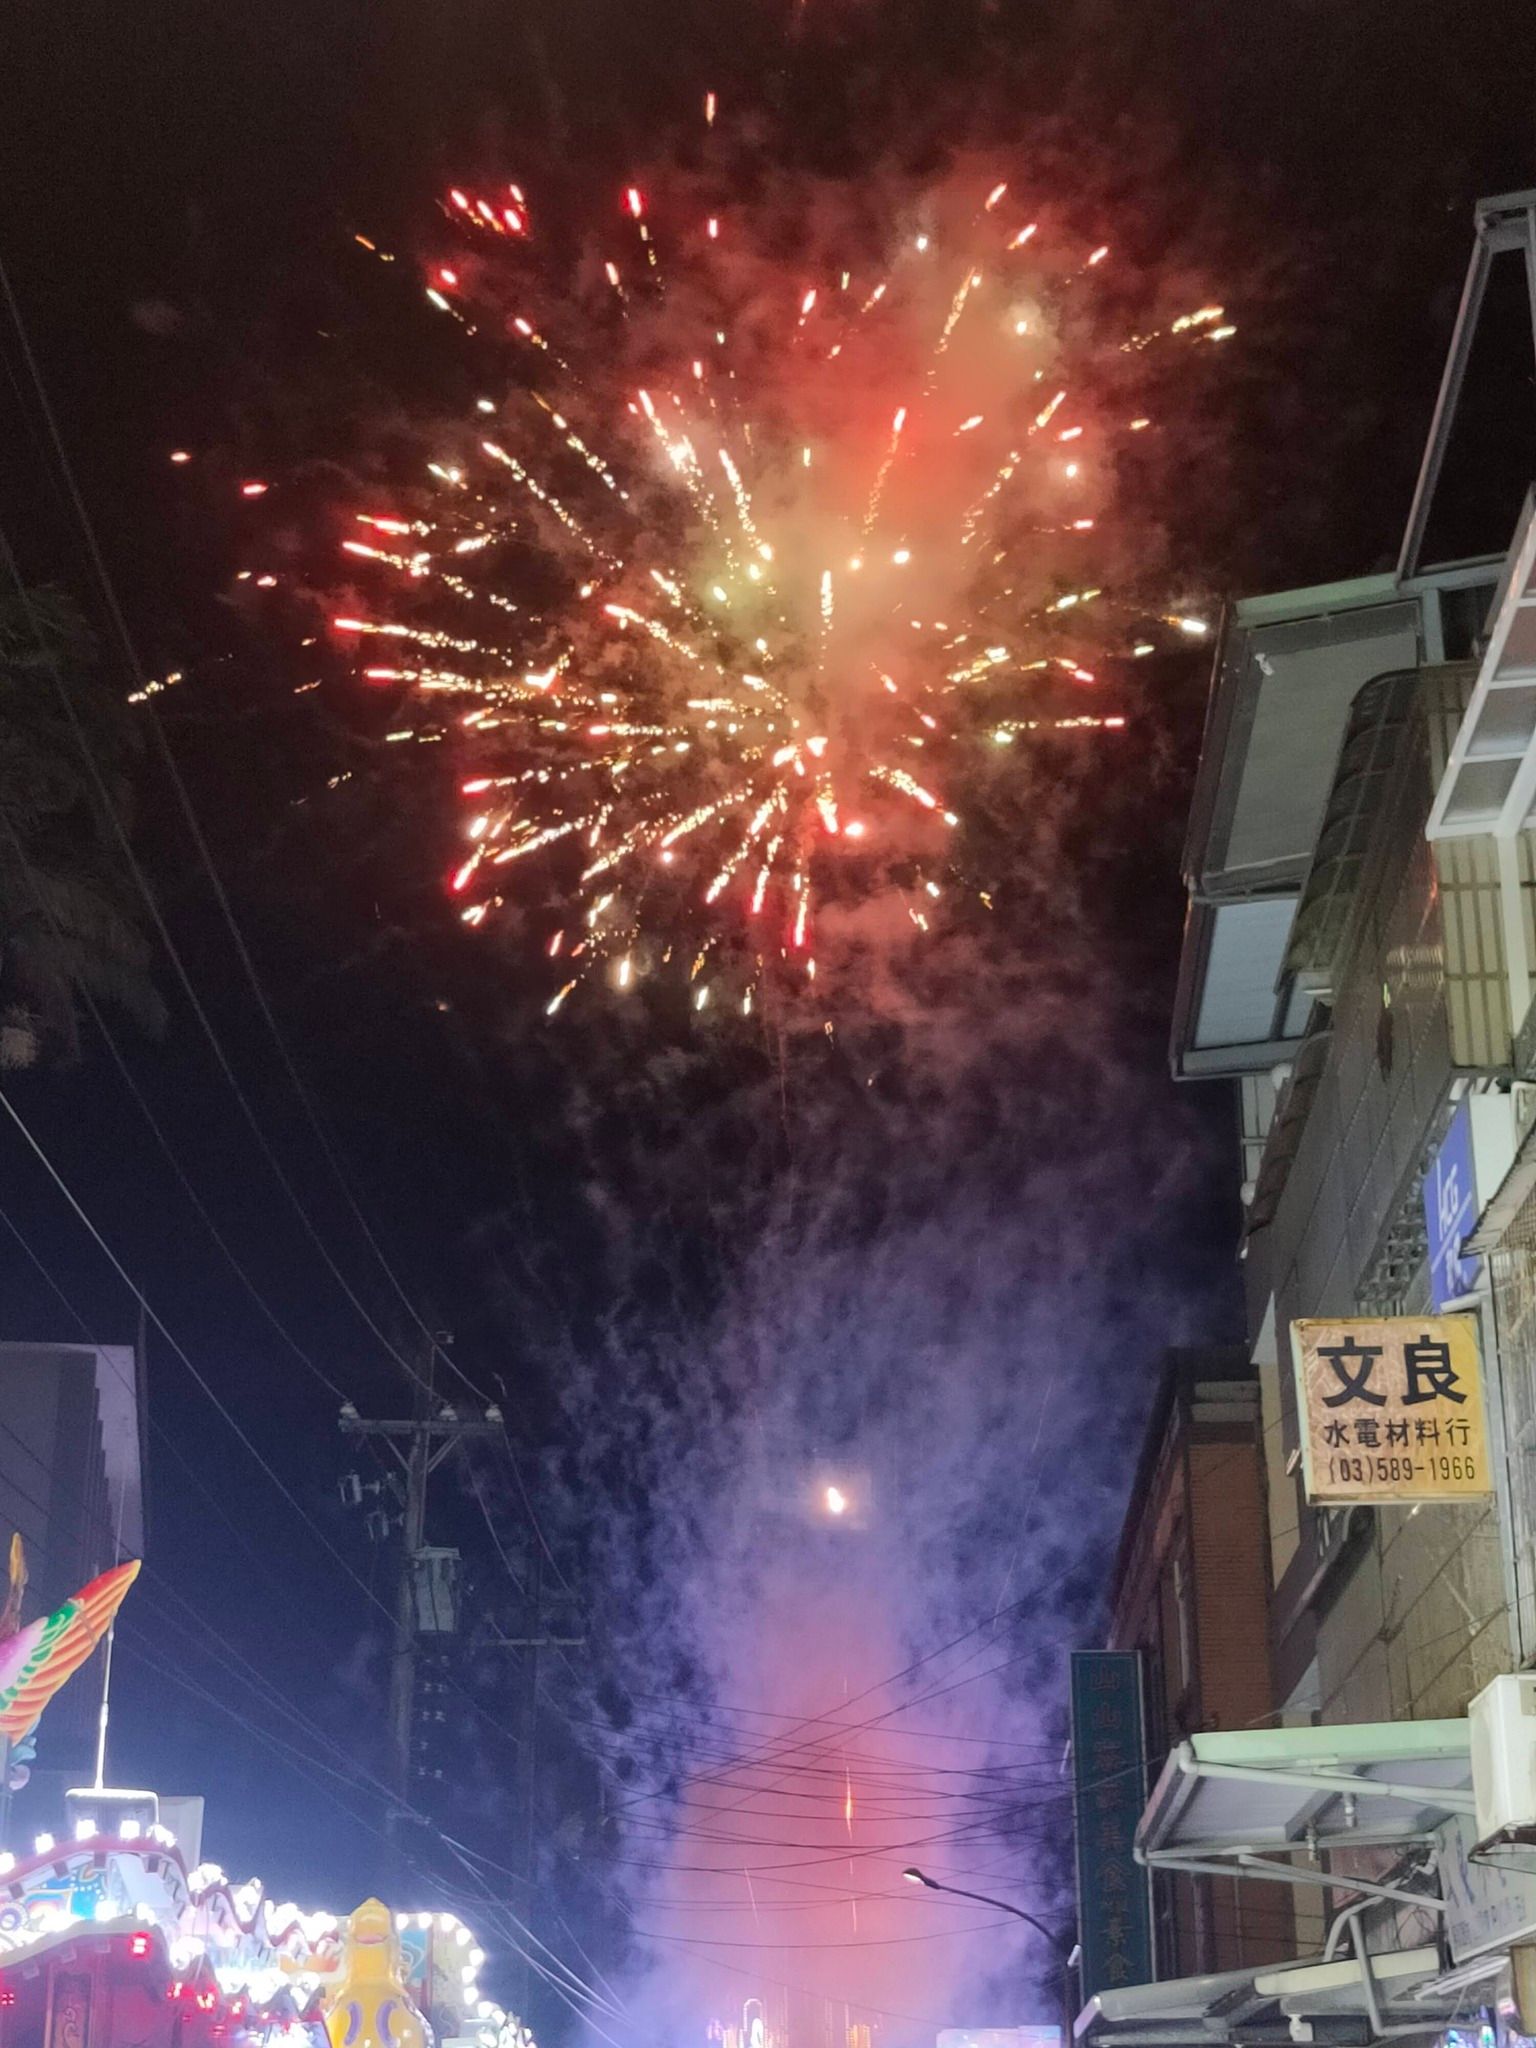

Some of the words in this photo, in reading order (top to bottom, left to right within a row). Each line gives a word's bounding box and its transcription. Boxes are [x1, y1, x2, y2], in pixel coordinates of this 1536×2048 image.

[1317, 1334, 1467, 1408] 文良
[1324, 1417, 1471, 1448] 水電材料行
[1329, 1456, 1475, 1484] (03)589-1966
